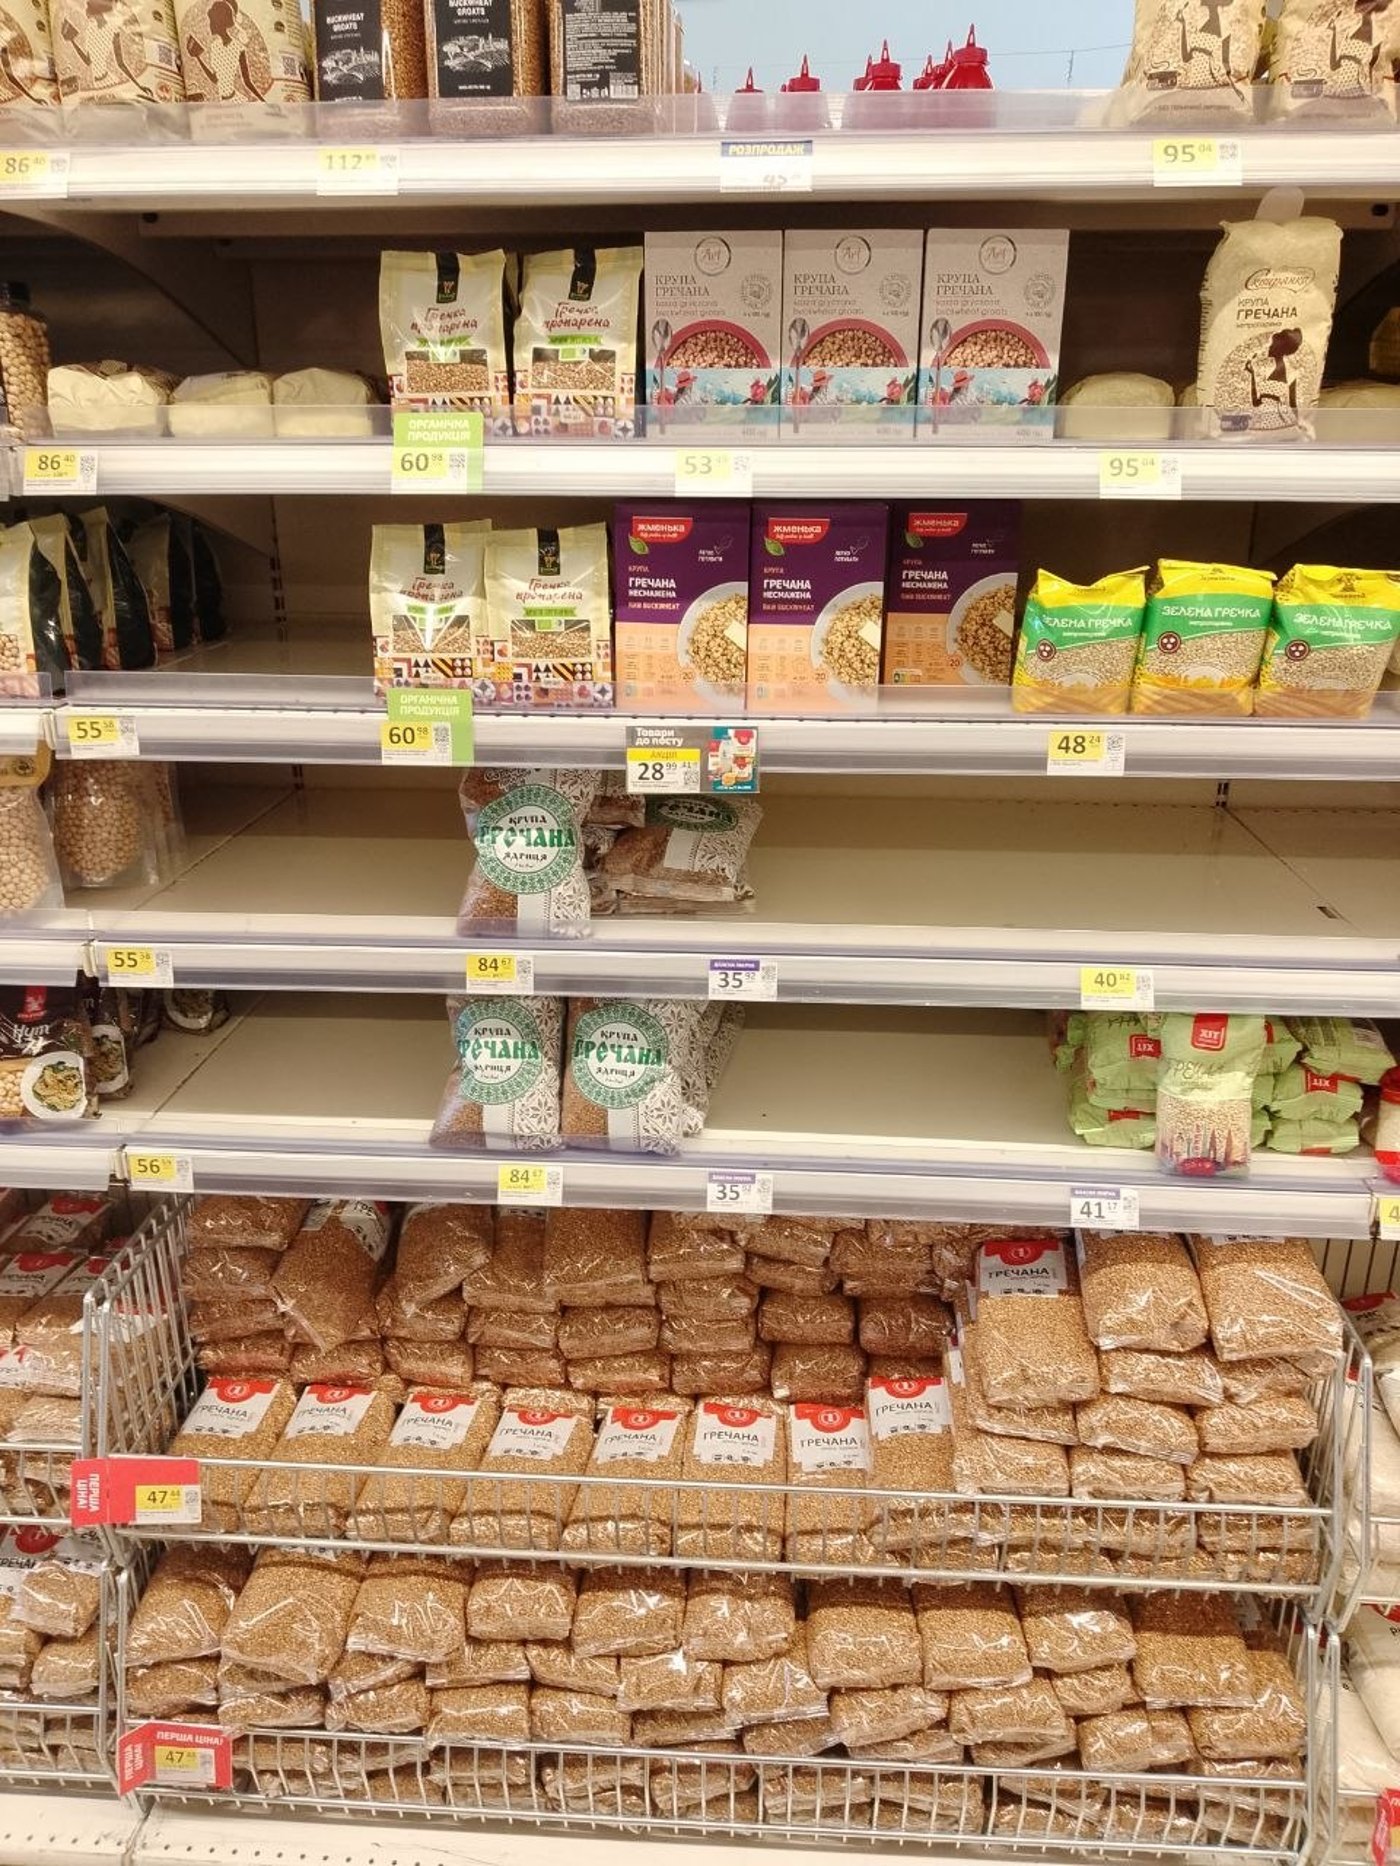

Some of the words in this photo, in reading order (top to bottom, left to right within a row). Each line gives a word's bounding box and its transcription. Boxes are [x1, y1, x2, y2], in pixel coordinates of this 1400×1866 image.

[729, 144, 804, 156] РОЗПРОДАЖ
[1163, 144, 1195, 163] 95
[5, 157, 29, 174] 86
[326, 154, 362, 170] 112
[655, 275, 697, 287] КРУПА
[794, 273, 836, 284] КРУПА
[936, 273, 980, 284] КРУПА
[656, 286, 712, 298] ГРЕЧАНА
[794, 285, 850, 296] ГРЕЧАНА
[936, 285, 994, 295] ГРЕЧАНА
[1237, 297, 1269, 307] КРУПА
[1236, 307, 1298, 320] ГРЕЧАНА
[544, 318, 610, 332] пропарена
[38, 454, 61, 471] 86
[401, 453, 429, 471] 60
[685, 455, 712, 474] 53
[1109, 457, 1139, 477] 95
[902, 570, 948, 580] ГРЕЧАНА
[628, 578, 676, 589] ГРЕЧАНА
[763, 579, 812, 590] ГРЕЧАНА
[902, 581, 948, 589] НЕСМАЖЕНА
[628, 590, 677, 598] НЕСМАЖЕНА
[763, 591, 812, 599] НЕСМАЖЕНА
[1162, 606, 1213, 618] ЗЕЛЕНА
[1214, 607, 1261, 618] ГРЕЧКА
[1088, 617, 1133, 629] ГРЕЧКА
[1293, 613, 1344, 628] ЗЕЛЕНА
[1345, 618, 1392, 630] ГРЕЧКА
[400, 694, 458, 705] ОРГАНІЧНА
[77, 721, 102, 739] 55
[389, 726, 415, 744] 60
[635, 728, 676, 739] Товари
[635, 738, 650, 746] до
[651, 738, 684, 747] посту
[1057, 735, 1086, 754] 48
[638, 762, 665, 781] 28
[666, 762, 678, 771] 99
[508, 815, 548, 825] КРУПА
[480, 824, 575, 850] ГРЕЧАНА
[114, 951, 138, 968] 55
[478, 957, 499, 972] 84
[717, 971, 743, 989] 35
[1094, 972, 1117, 988] 40
[473, 1027, 511, 1037] КРУПА
[600, 1030, 638, 1042] КРУПА
[574, 1038, 662, 1067] ГРЕЧАНА
[137, 1158, 160, 1174] 56
[510, 1168, 530, 1183] 84
[716, 1184, 740, 1201] 35
[1080, 1201, 1106, 1219] 41
[988, 1267, 1050, 1279] ГРЕЧАНА
[196, 1402, 246, 1417] ГРЕЧАНА
[295, 1404, 343, 1417] ГРЕЧАНА
[875, 1401, 933, 1416] ГРЕЧАНА
[403, 1414, 452, 1427] ГРЕЧАНА
[496, 1425, 549, 1437] ГРЕЧАНА
[703, 1430, 759, 1443] ГРЕЧАНА
[603, 1432, 657, 1445] ГРЕЧАНА
[799, 1436, 858, 1448] ГРЕЧАНА
[88, 1473, 101, 1513] ПЕРША
[147, 1490, 168, 1504] 47
[156, 1731, 194, 1742] ПЕРША
[165, 1750, 184, 1763] 47
